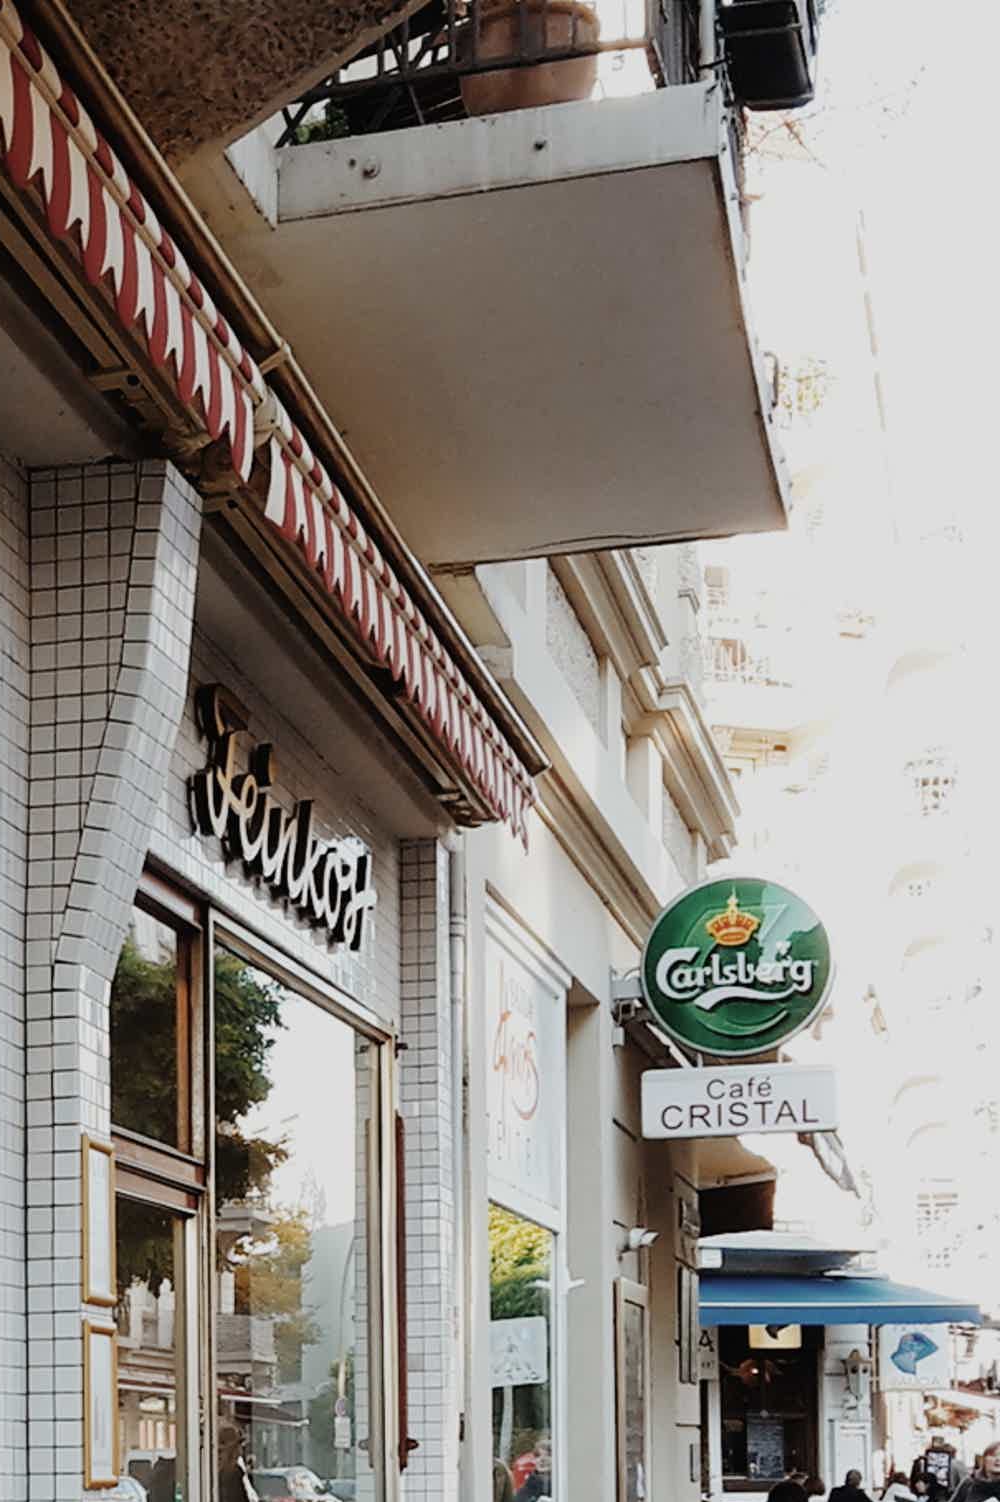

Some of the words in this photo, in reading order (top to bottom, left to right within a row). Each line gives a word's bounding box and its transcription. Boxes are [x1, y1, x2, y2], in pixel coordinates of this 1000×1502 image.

[655, 942, 815, 1005] Carlsberg
[706, 1076, 772, 1100] Café
[660, 1099, 819, 1130] CRISTAL
